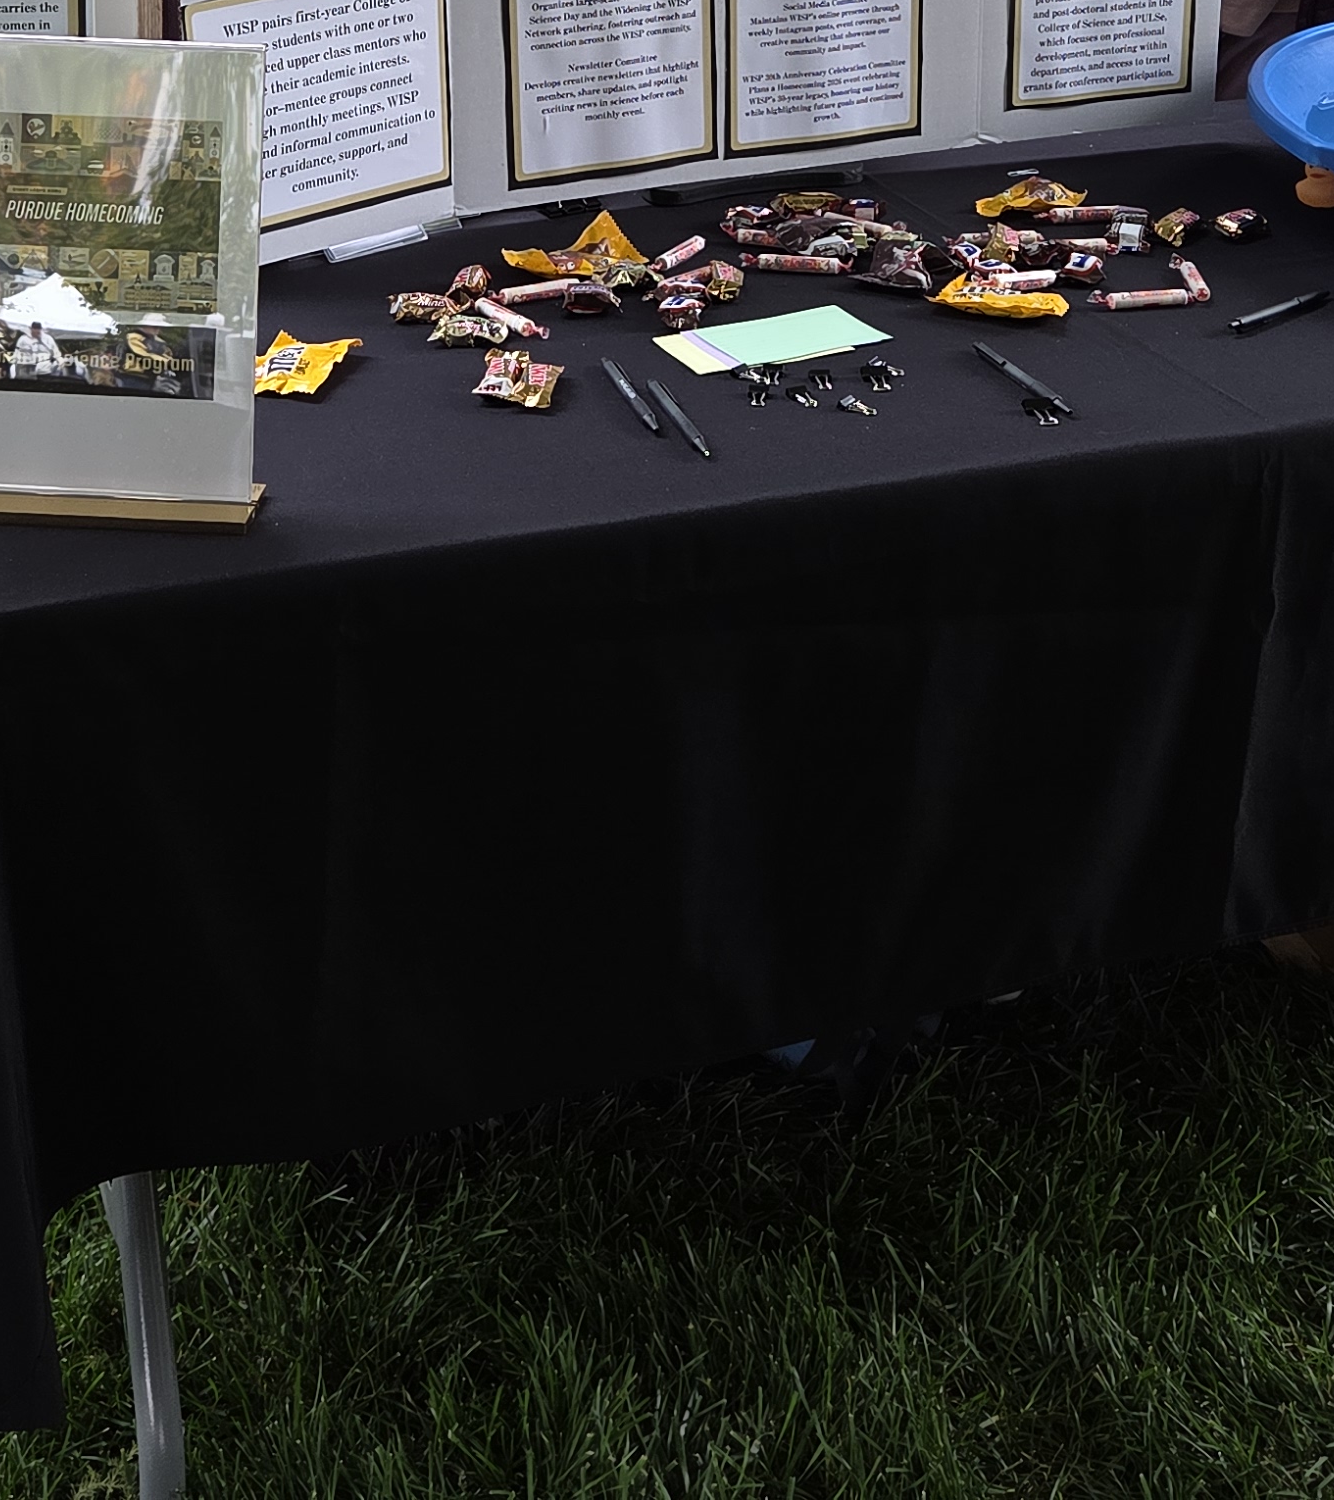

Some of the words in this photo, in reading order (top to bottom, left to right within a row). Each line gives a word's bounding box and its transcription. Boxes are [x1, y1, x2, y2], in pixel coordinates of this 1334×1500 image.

[39, 2, 59, 13] the
[223, 20, 259, 38] WISP
[262, 15, 292, 33] pairs
[296, 4, 350, 24] first-year
[1033, 9, 1050, 19] and
[1052, 5, 1108, 20] post-doctoral
[1110, 2, 1146, 12] students
[1148, 0, 1157, 8] in
[39, 20, 50, 30] in
[272, 30, 322, 51] students
[325, 23, 350, 38] with
[354, 22, 374, 33] one
[378, 17, 390, 28] or
[393, 12, 414, 25] two
[1038, 23, 1070, 33] College
[1072, 20, 1080, 30] of
[1082, 18, 1115, 29] Science
[1117, 15, 1133, 25] and
[287, 52, 320, 71] upper
[323, 45, 351, 61] class
[354, 35, 400, 54] mentors
[403, 30, 426, 43] who
[271, 78, 299, 94] their
[302, 65, 356, 87] academic
[359, 55, 410, 73] interests.
[329, 82, 367, 104] groups
[370, 72, 413, 92] connect
[280, 113, 328, 135] monthly
[332, 102, 385, 123] meetings,
[387, 90, 419, 108] WISP
[262, 145, 278, 159] nd
[281, 132, 332, 155] informal
[335, 112, 422, 142] communication
[424, 109, 435, 120] to
[280, 155, 336, 177] guidance,
[338, 140, 384, 161] support,
[387, 133, 408, 148] and
[292, 168, 359, 193] community.
[5, 200, 64, 220] PURDUE
[65, 203, 164, 225] HOMECOMING
[125, 353, 195, 374] Program
